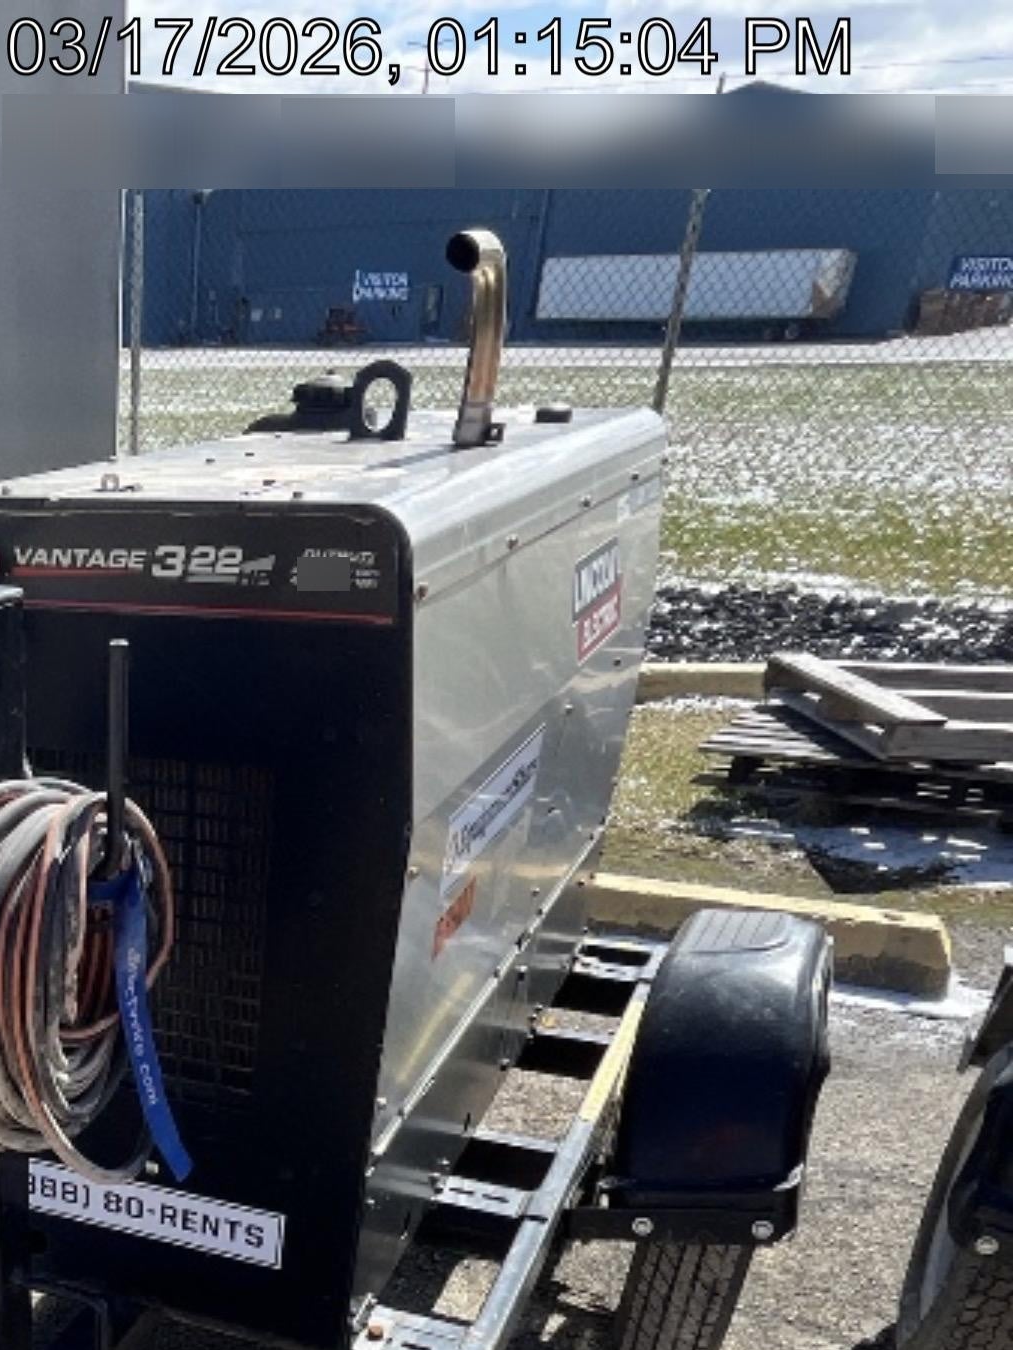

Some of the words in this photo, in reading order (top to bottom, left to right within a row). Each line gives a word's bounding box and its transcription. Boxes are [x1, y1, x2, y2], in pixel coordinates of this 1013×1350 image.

[13, 546, 148, 570] VANTAGE
[151, 544, 242, 578] 322
[103, 1190, 265, 1250] 80-RENTS
